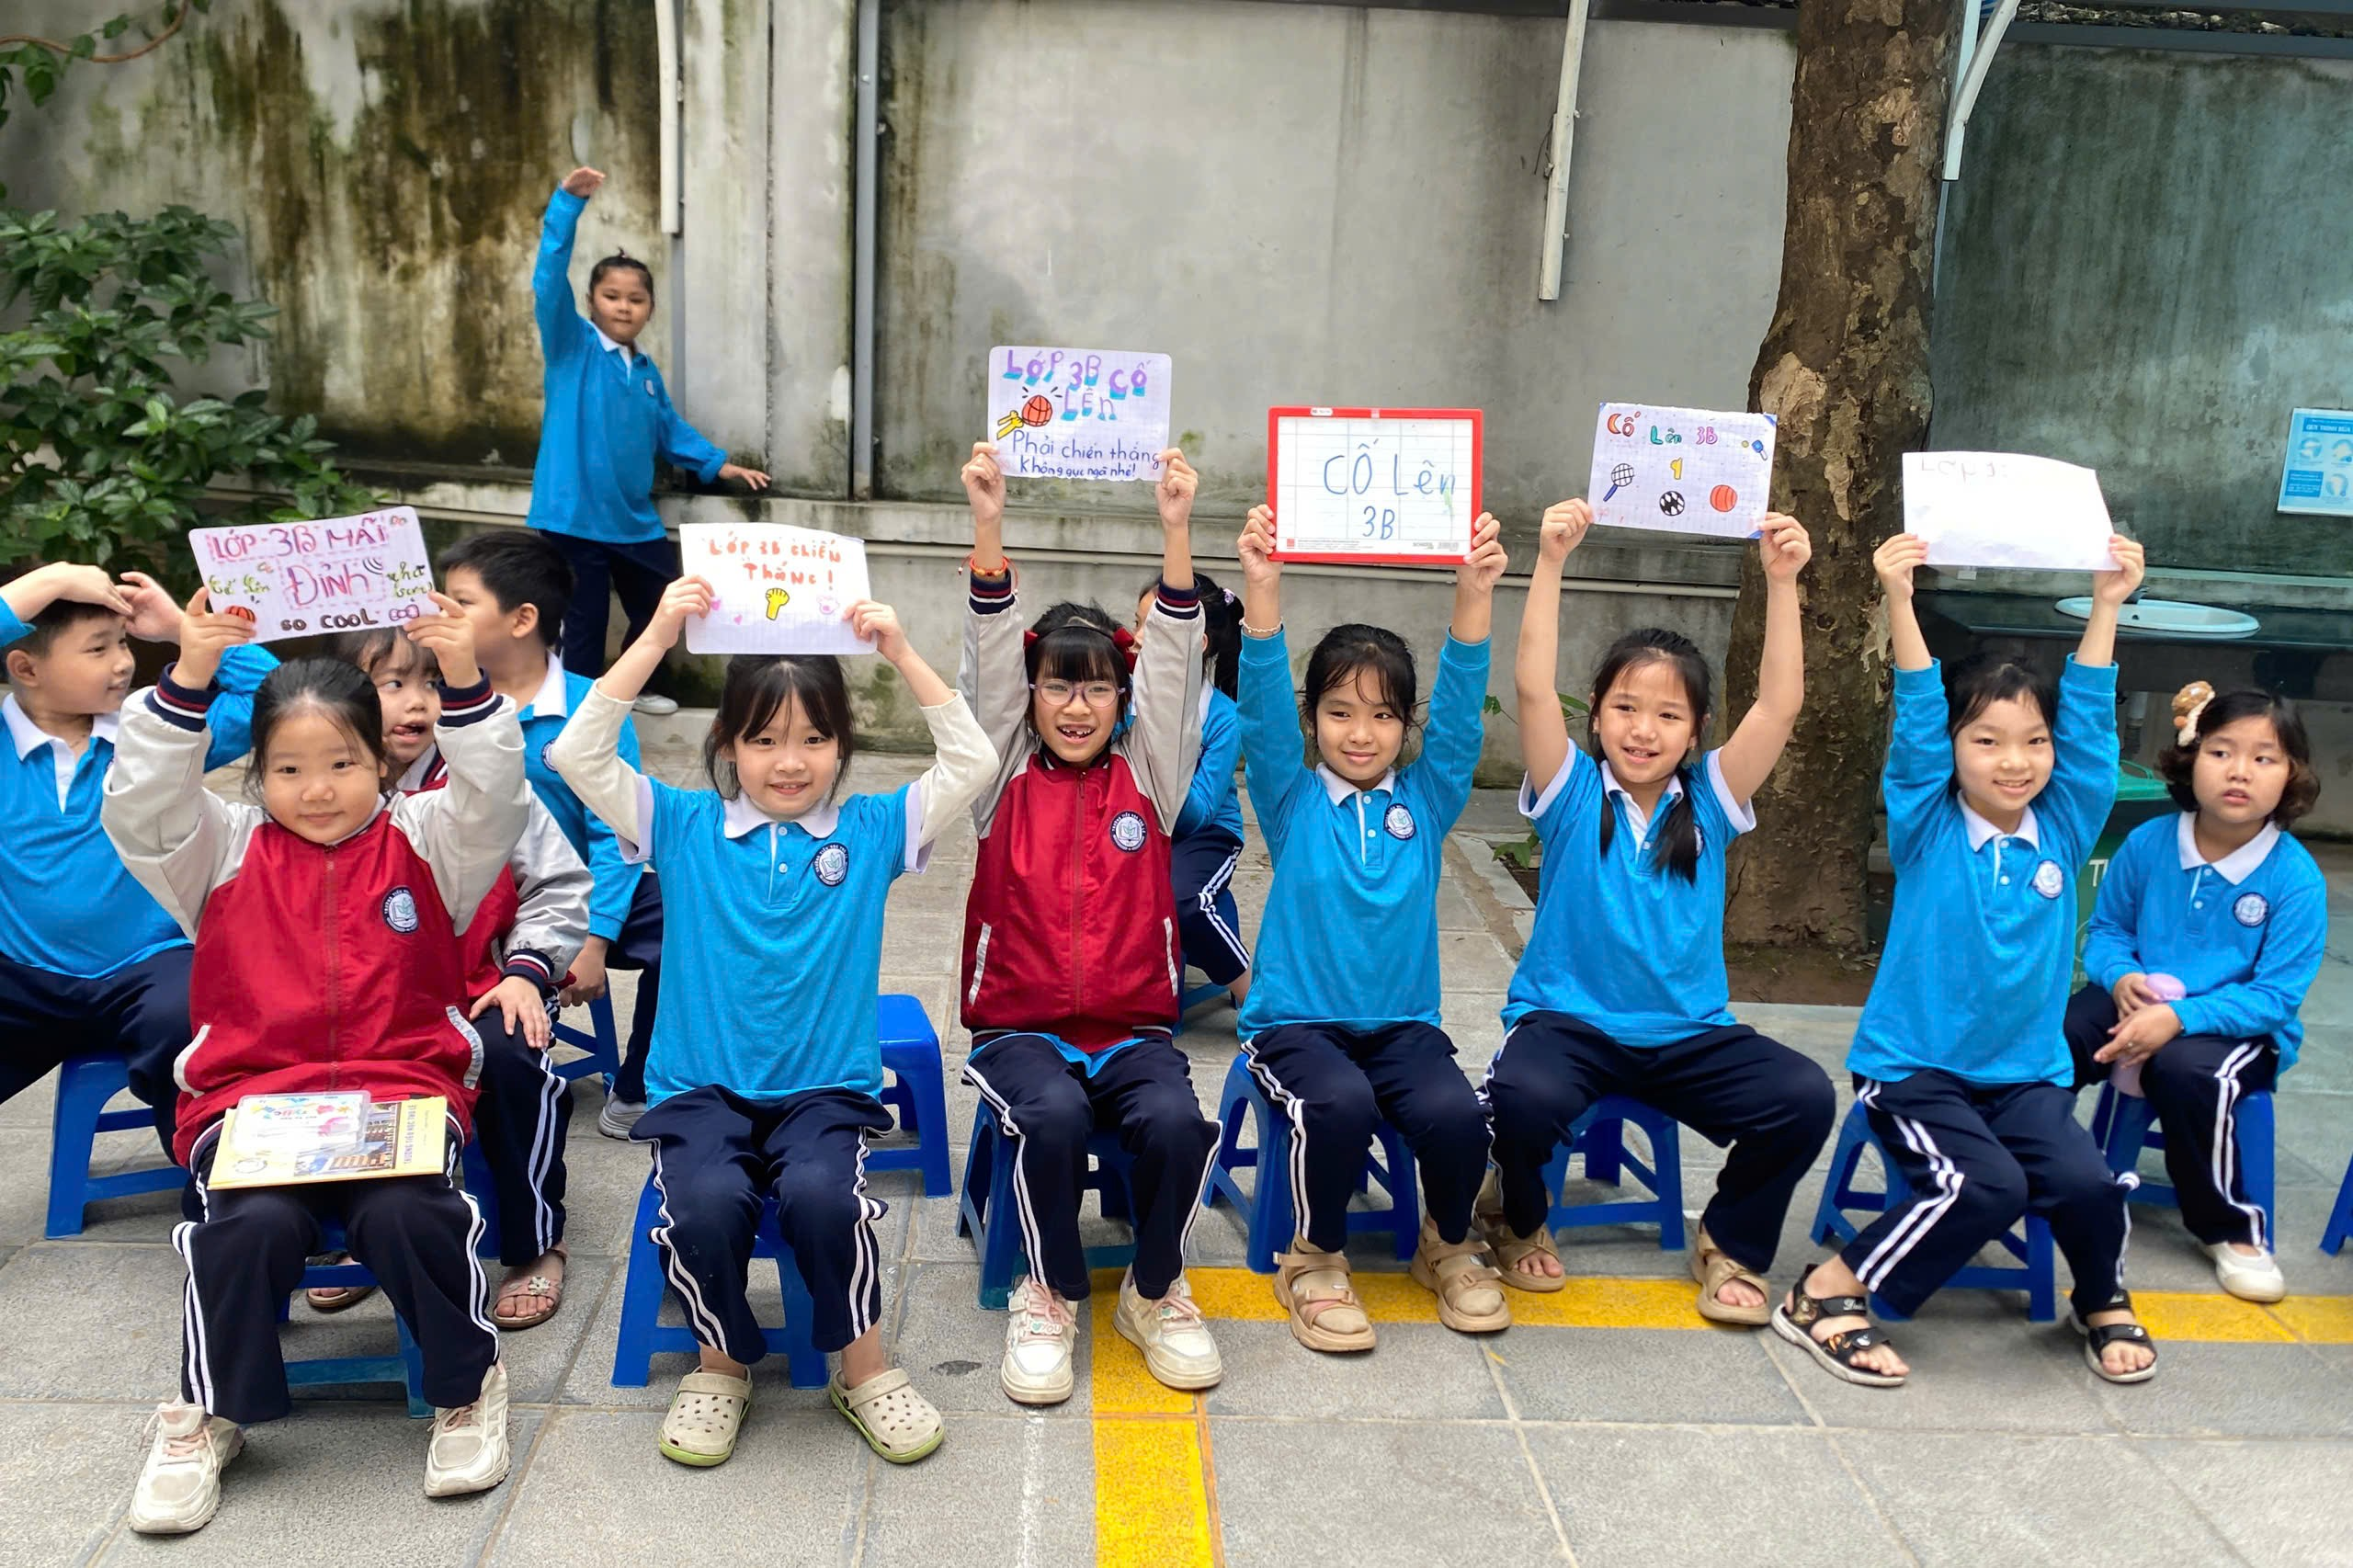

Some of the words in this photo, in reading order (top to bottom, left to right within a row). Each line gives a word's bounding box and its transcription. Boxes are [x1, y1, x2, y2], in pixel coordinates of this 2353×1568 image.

[1066, 354, 1102, 392] 3B
[1012, 429, 1054, 455] Phải
[1695, 426, 1718, 445] 3B
[1393, 453, 1456, 495] Lên
[212, 528, 256, 559] LỚP
[268, 525, 317, 557] 3B
[325, 517, 388, 550] MÃI
[1362, 506, 1395, 540] 3B
[758, 540, 780, 555] 3B
